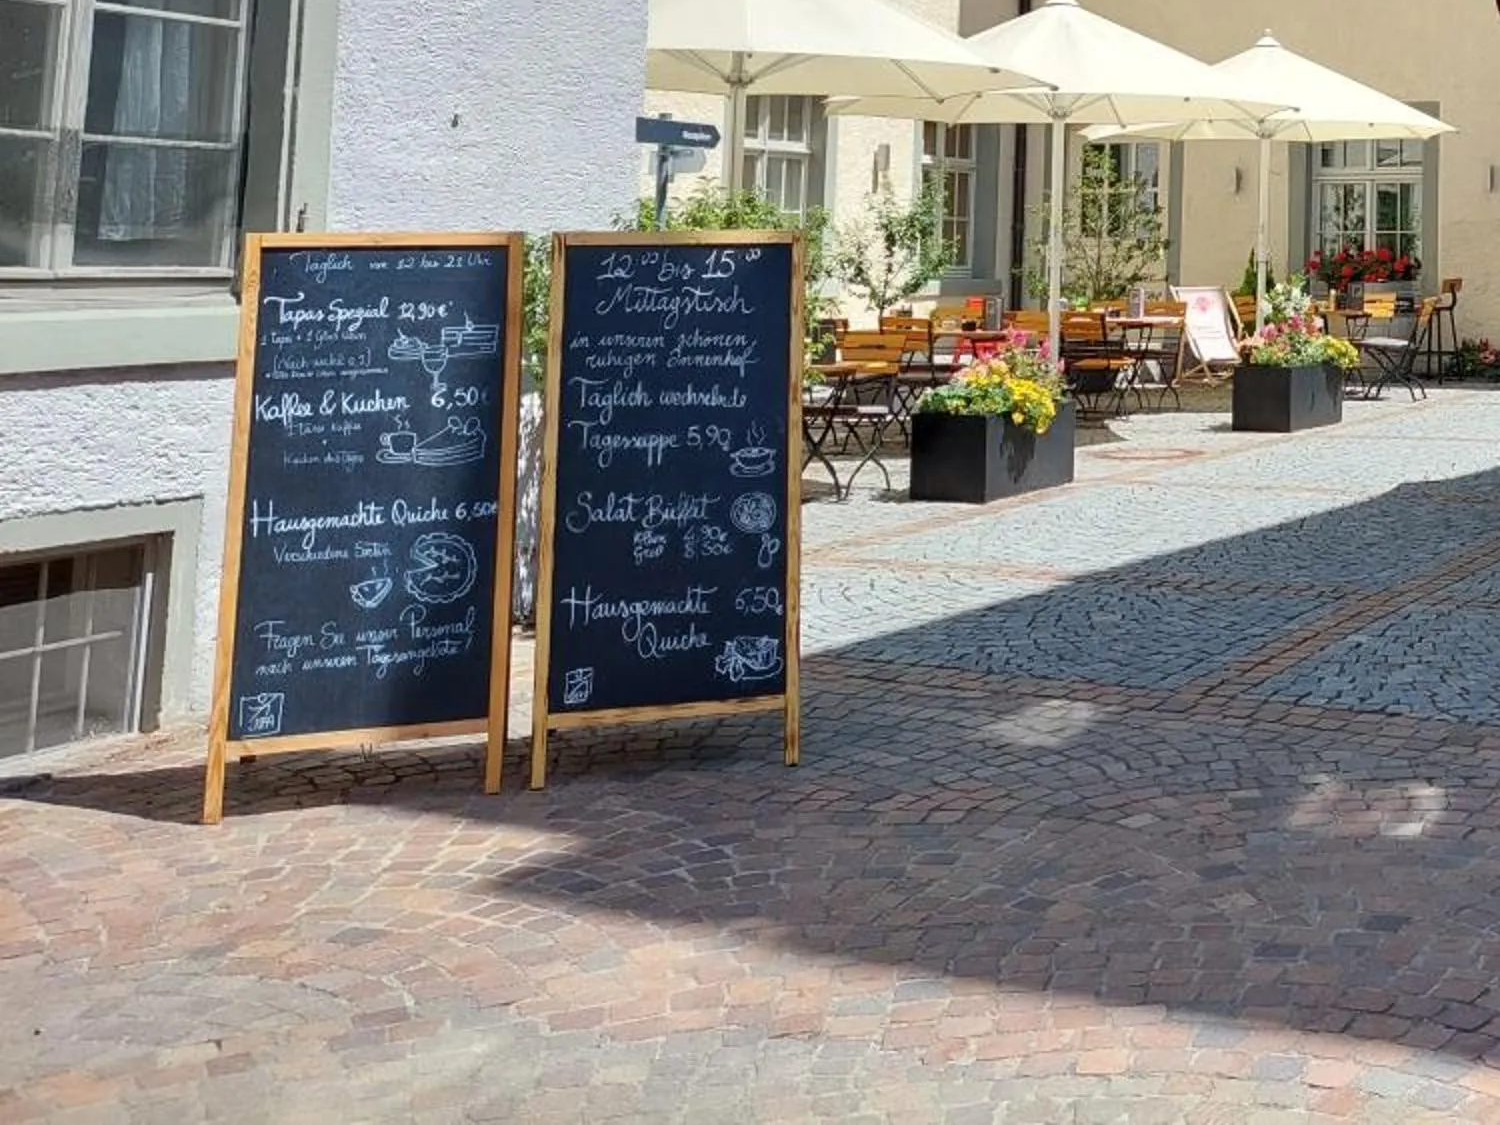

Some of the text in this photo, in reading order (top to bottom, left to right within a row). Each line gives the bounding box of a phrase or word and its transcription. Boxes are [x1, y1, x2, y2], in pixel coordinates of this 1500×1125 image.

[290, 252, 352, 283] Täglich
[396, 256, 415, 270] 12
[443, 255, 464, 269] 21
[467, 252, 493, 267] Uhr
[657, 250, 696, 282] bis
[263, 292, 324, 329] Tapas
[327, 296, 390, 331] Spezial
[596, 283, 755, 330] Mittagstisch
[569, 331, 590, 351] in
[586, 347, 760, 377] ruhigen Innenhof
[255, 392, 315, 425] Kaffee
[319, 390, 337, 415] &
[341, 389, 411, 412] Kuchen
[568, 377, 652, 424] Täglich
[568, 421, 680, 469] Tagessuppe
[250, 498, 385, 550] Hausgemachte
[391, 497, 448, 527] Quiche
[566, 491, 644, 534] Salat
[274, 540, 393, 563] Verschiedene Sorten
[253, 604, 476, 657] Fragen Sie unser Personal
[561, 584, 719, 643] Hausgemachte
[637, 622, 712, 659] Quiche
[255, 661, 293, 676] nach
